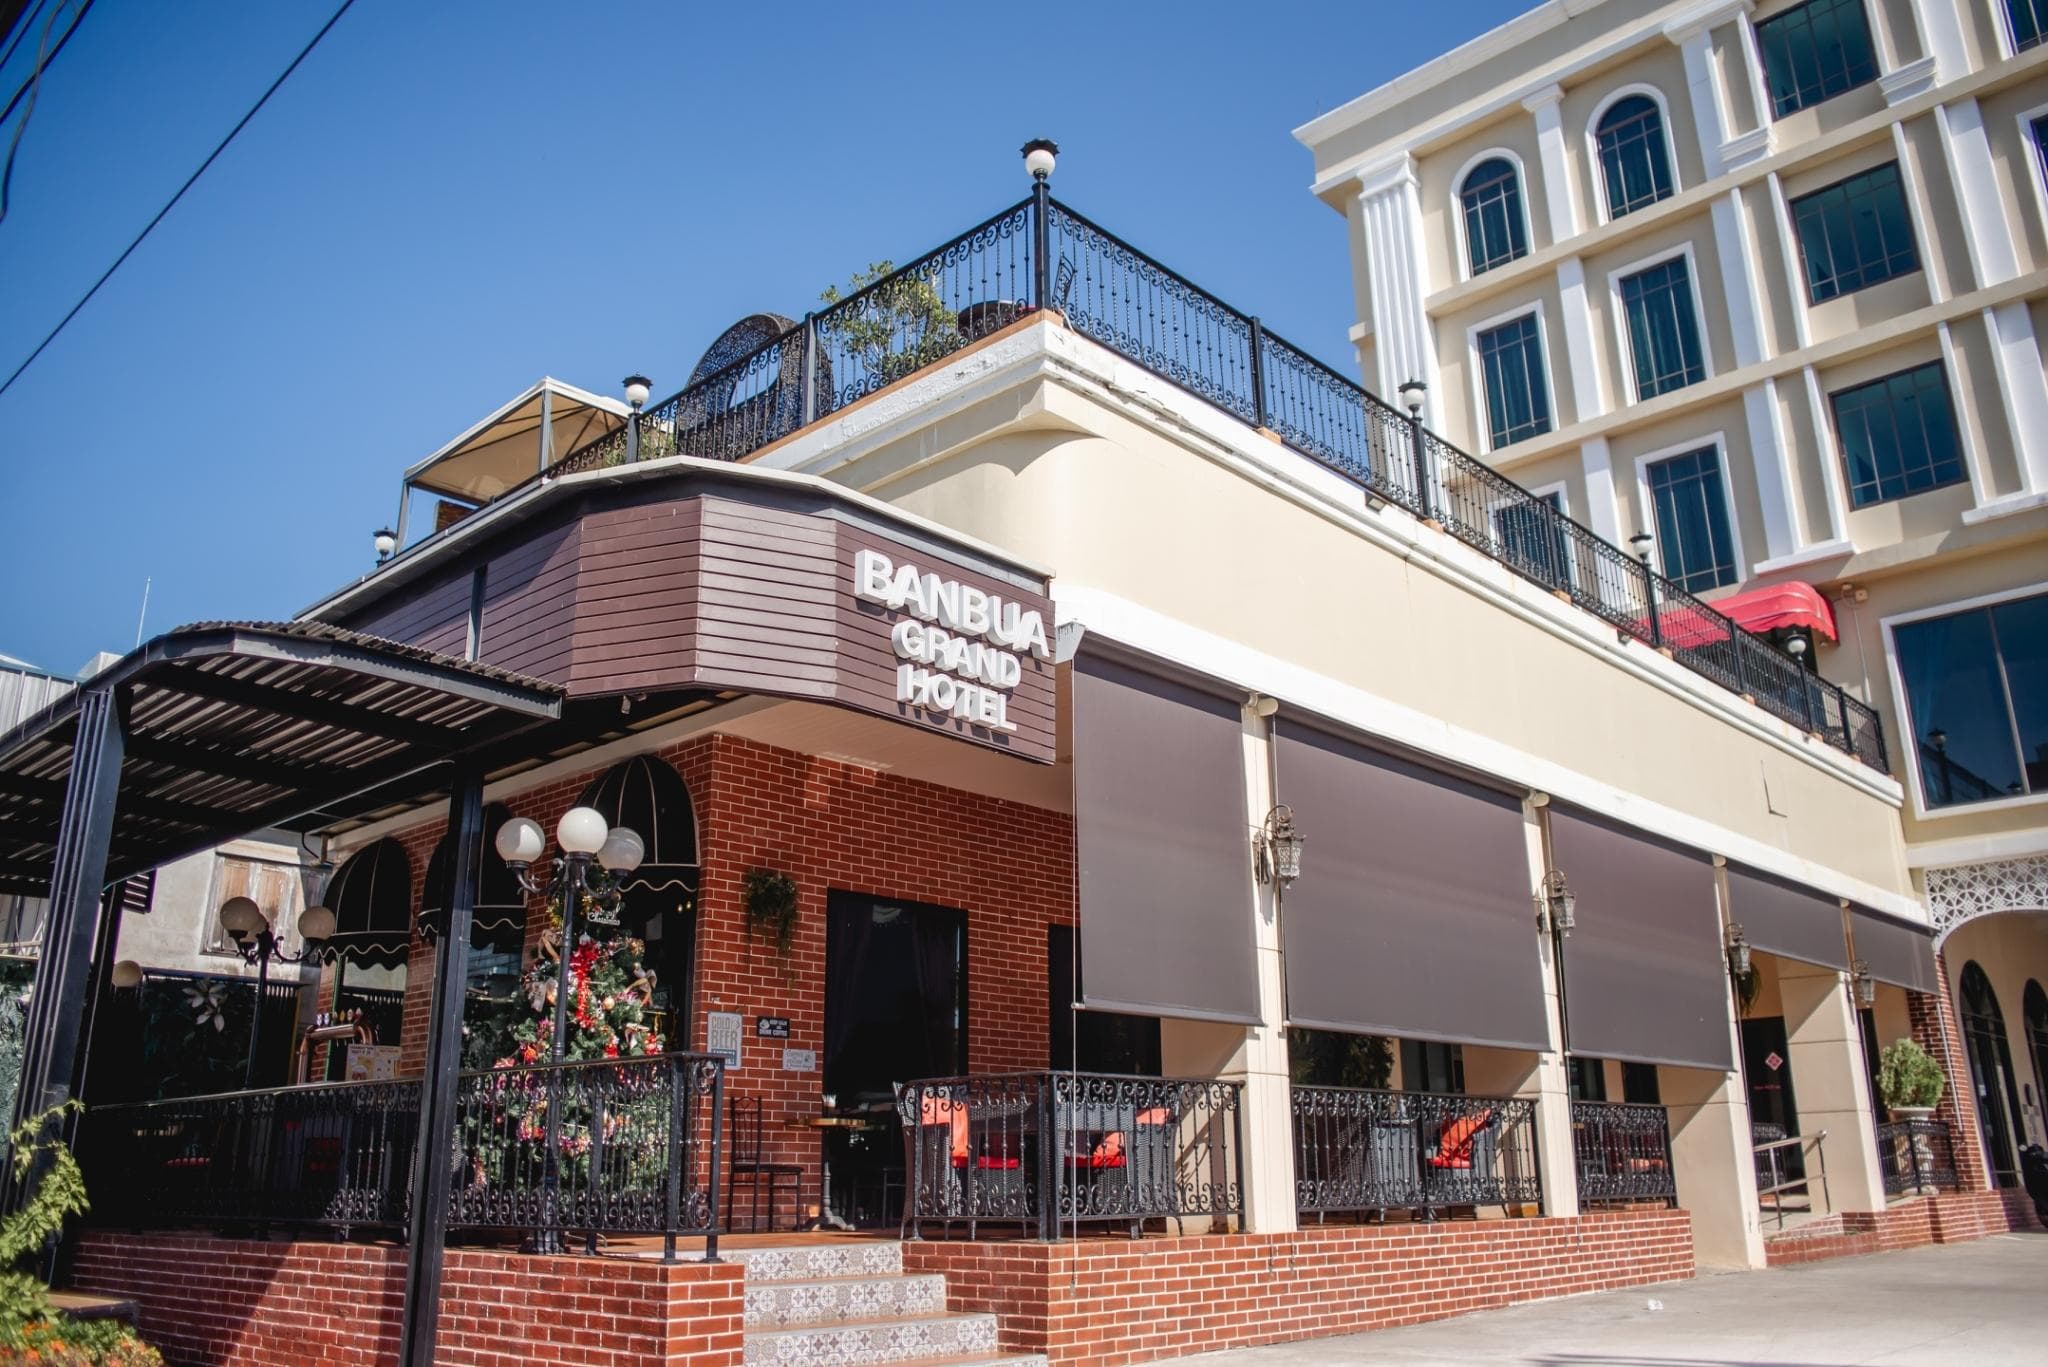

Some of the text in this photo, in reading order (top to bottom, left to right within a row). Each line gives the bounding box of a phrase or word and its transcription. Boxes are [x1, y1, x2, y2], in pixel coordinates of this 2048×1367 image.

[855, 549, 1050, 657] BANBUA
[891, 619, 1021, 689] GRAND
[897, 663, 1017, 731] HOTEL
[711, 1030, 738, 1049] BEER
